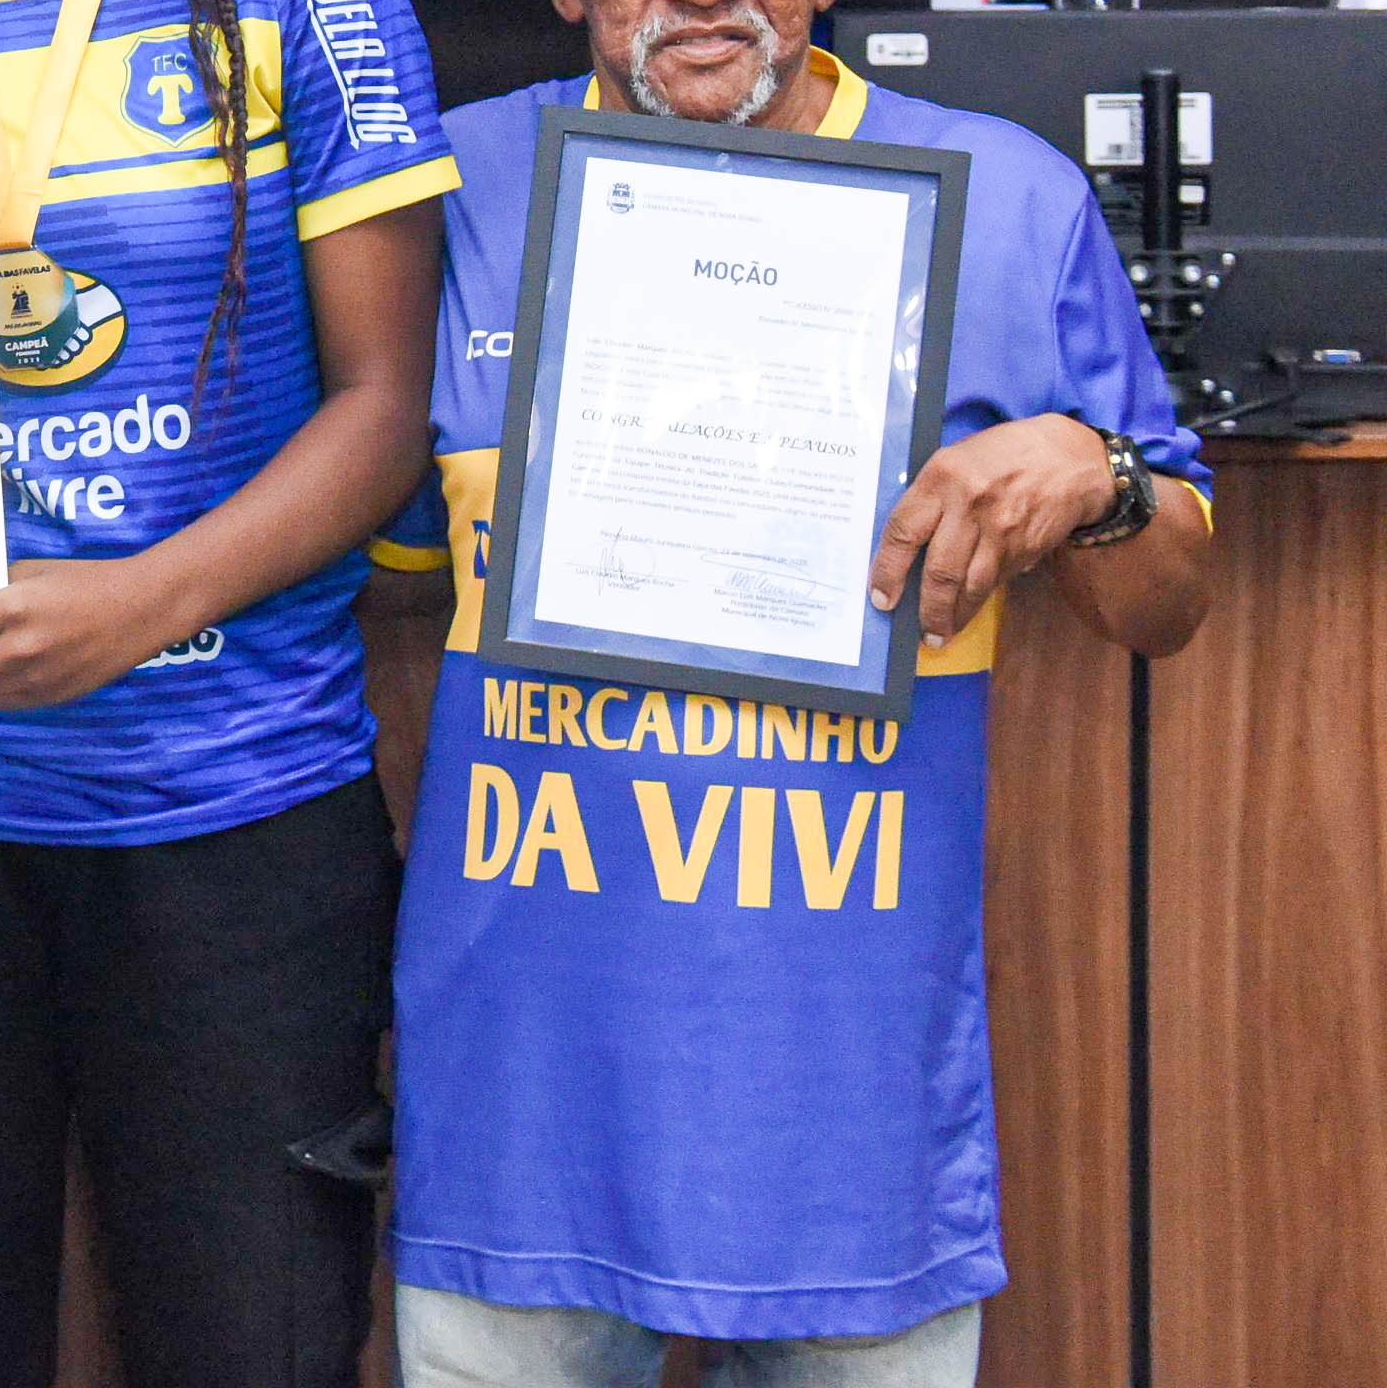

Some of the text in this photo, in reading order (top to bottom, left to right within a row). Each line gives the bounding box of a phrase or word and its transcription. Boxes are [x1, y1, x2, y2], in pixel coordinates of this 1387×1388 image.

[151, 52, 188, 73] TFC
[343, 68, 417, 144] LLOG
[693, 259, 778, 286] MOÇÃO
[4, 336, 49, 351] CAMPEÃ
[580, 407, 858, 458] COGRULAÇÕES E PLAUSOS
[10, 467, 126, 521] ivre
[483, 677, 899, 765] MERCADINHO
[462, 763, 905, 911] DA VIVI
